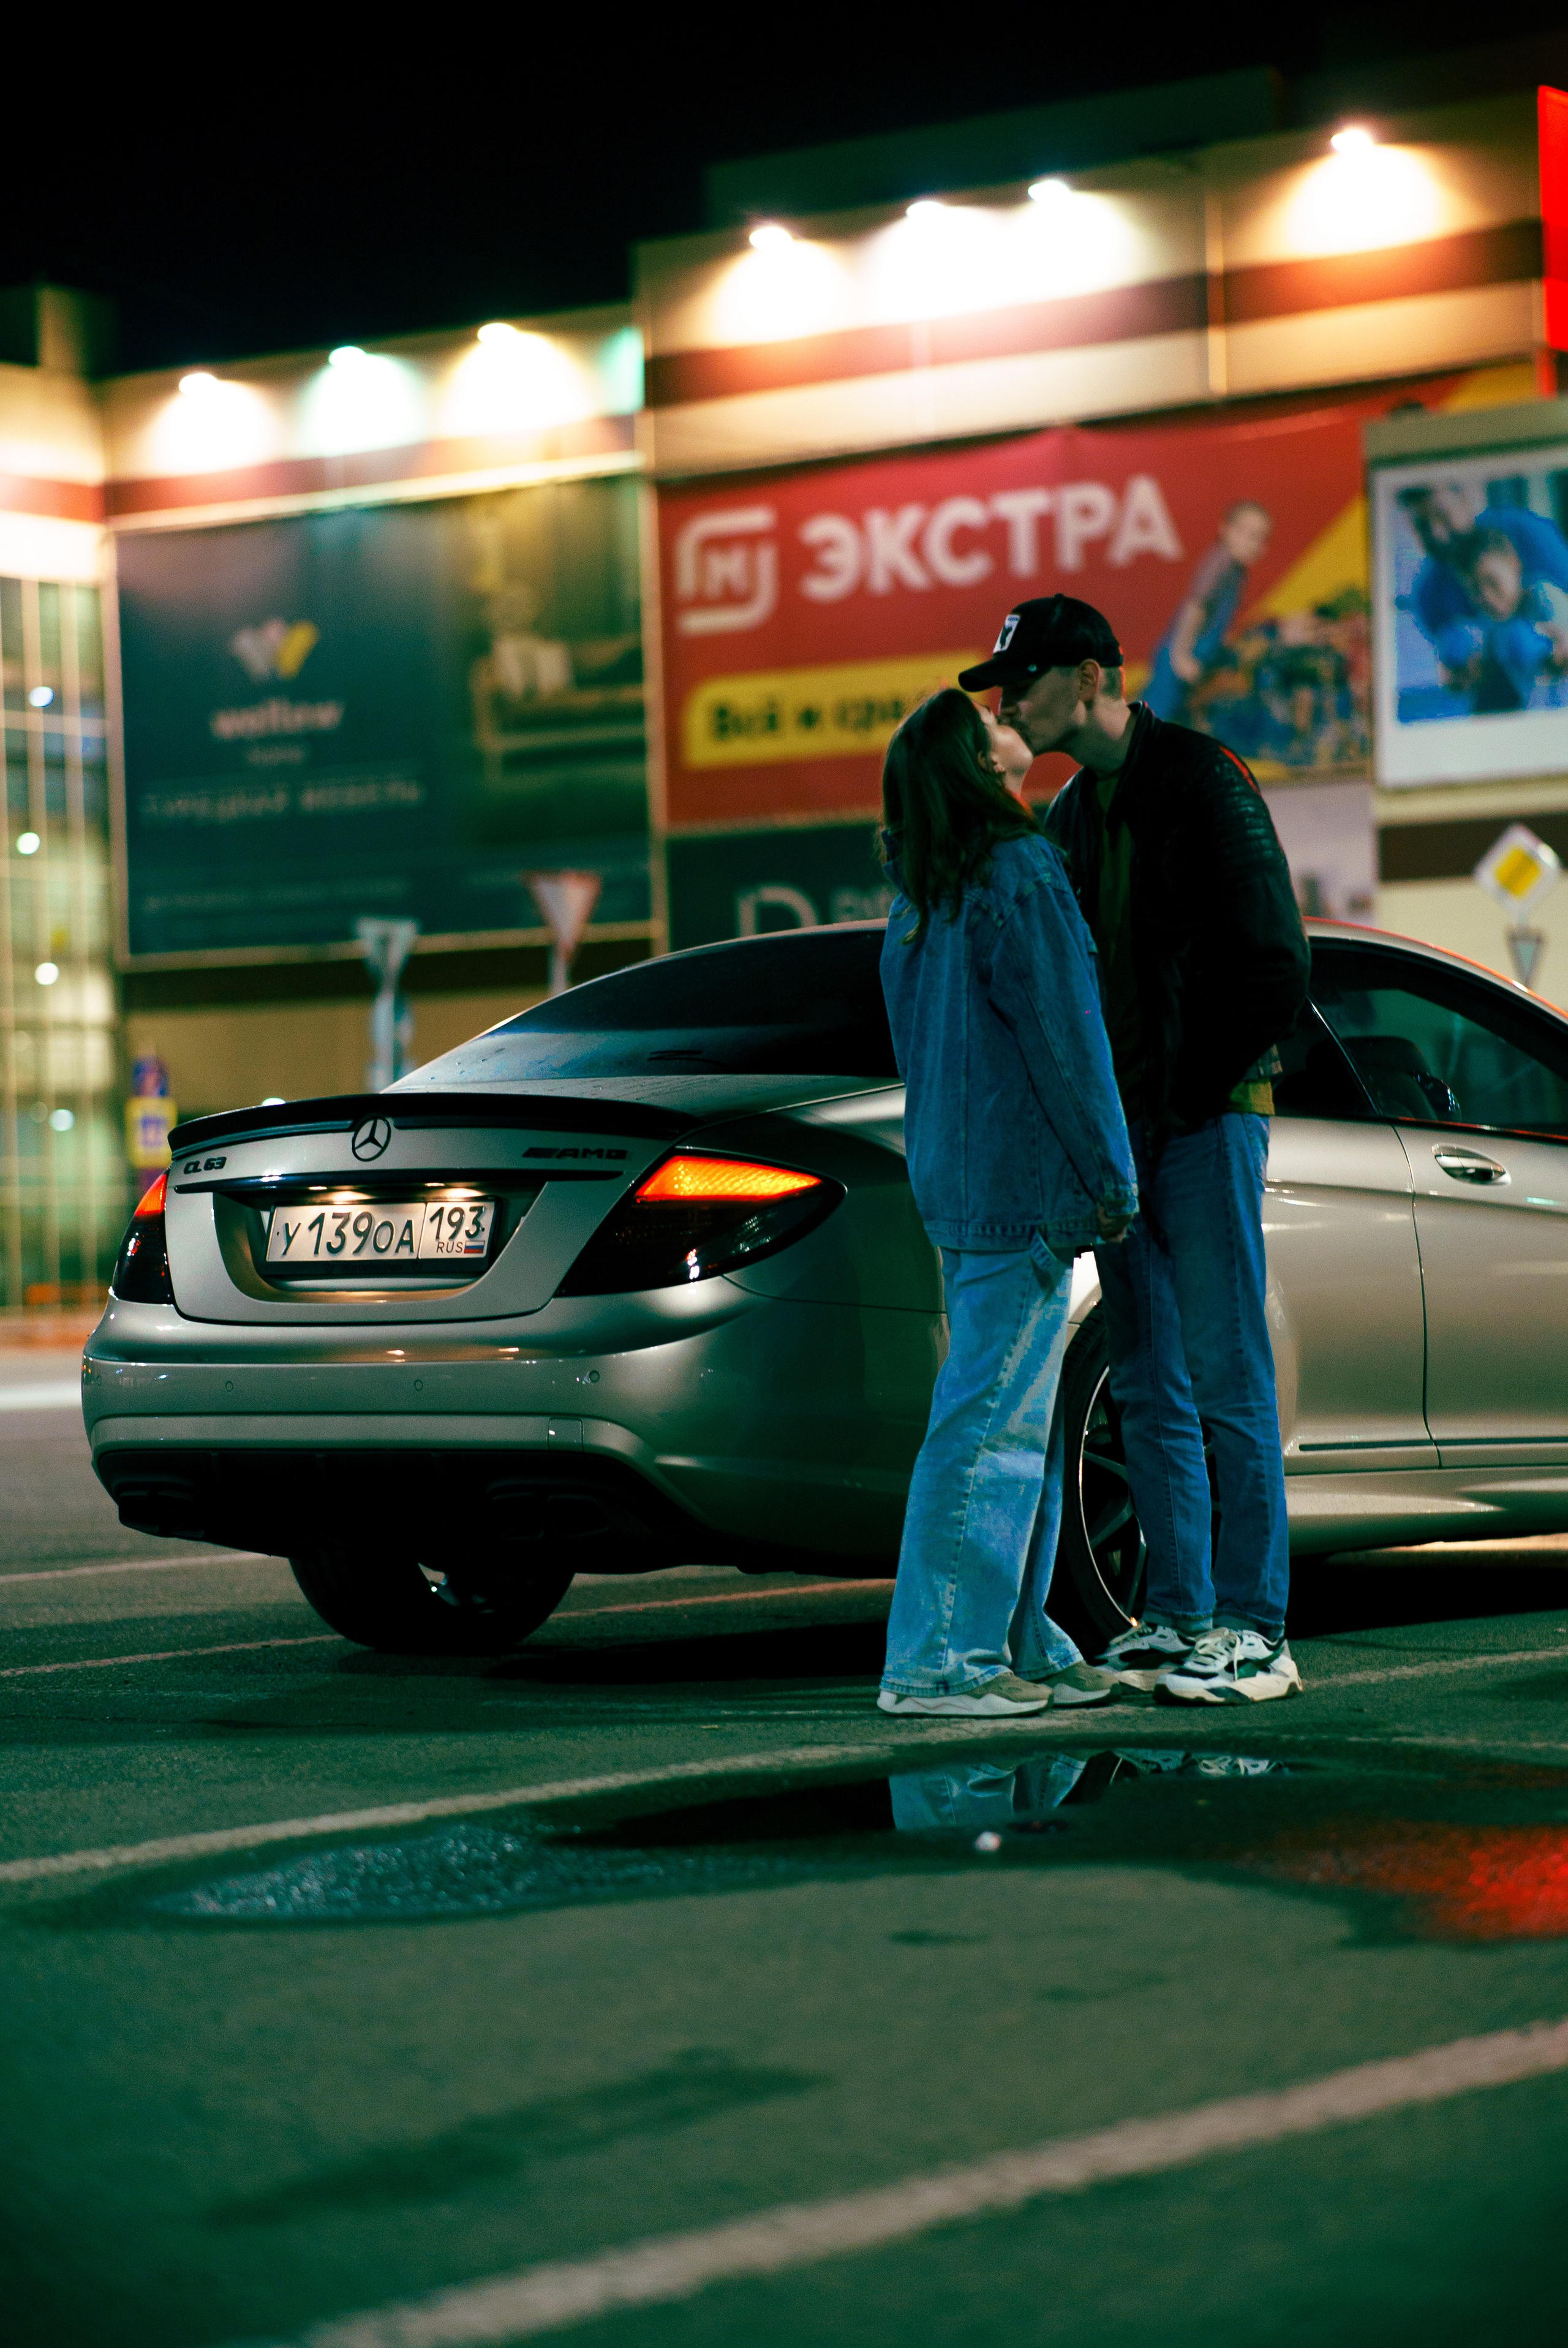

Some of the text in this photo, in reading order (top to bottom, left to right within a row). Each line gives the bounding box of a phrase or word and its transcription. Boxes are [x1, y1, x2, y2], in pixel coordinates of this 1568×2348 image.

[799, 473, 1182, 602] ЭКСТРА
[183, 1156, 227, 1174] CL 63
[429, 1206, 485, 1240] 193
[436, 1241, 463, 1253] RUS
